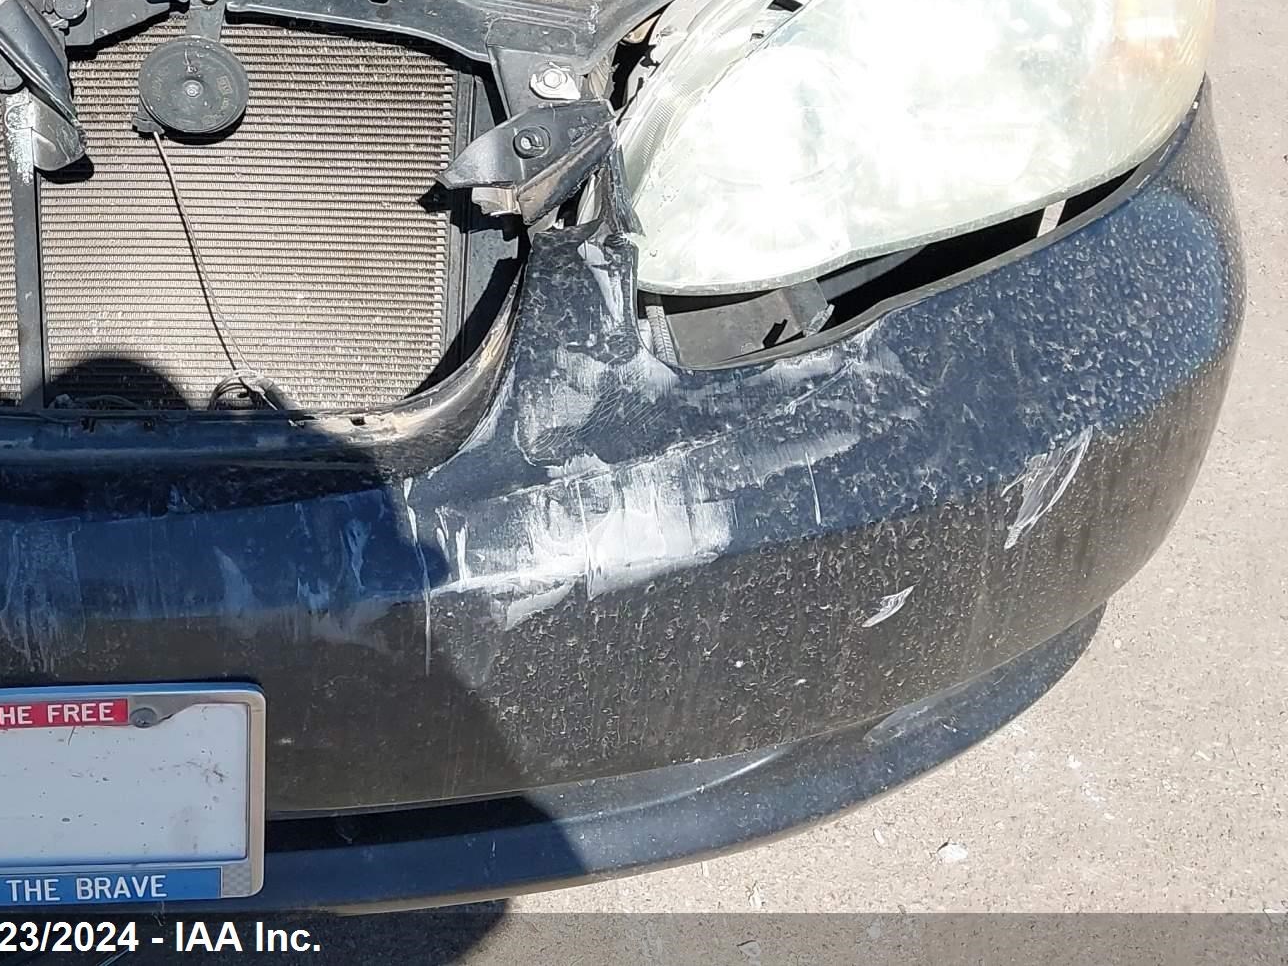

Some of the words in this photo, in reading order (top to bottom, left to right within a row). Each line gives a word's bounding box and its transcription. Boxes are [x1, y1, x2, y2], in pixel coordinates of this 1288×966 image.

[47, 702, 115, 724] FREE
[6, 879, 61, 902] THE
[76, 875, 168, 900] BRAVE
